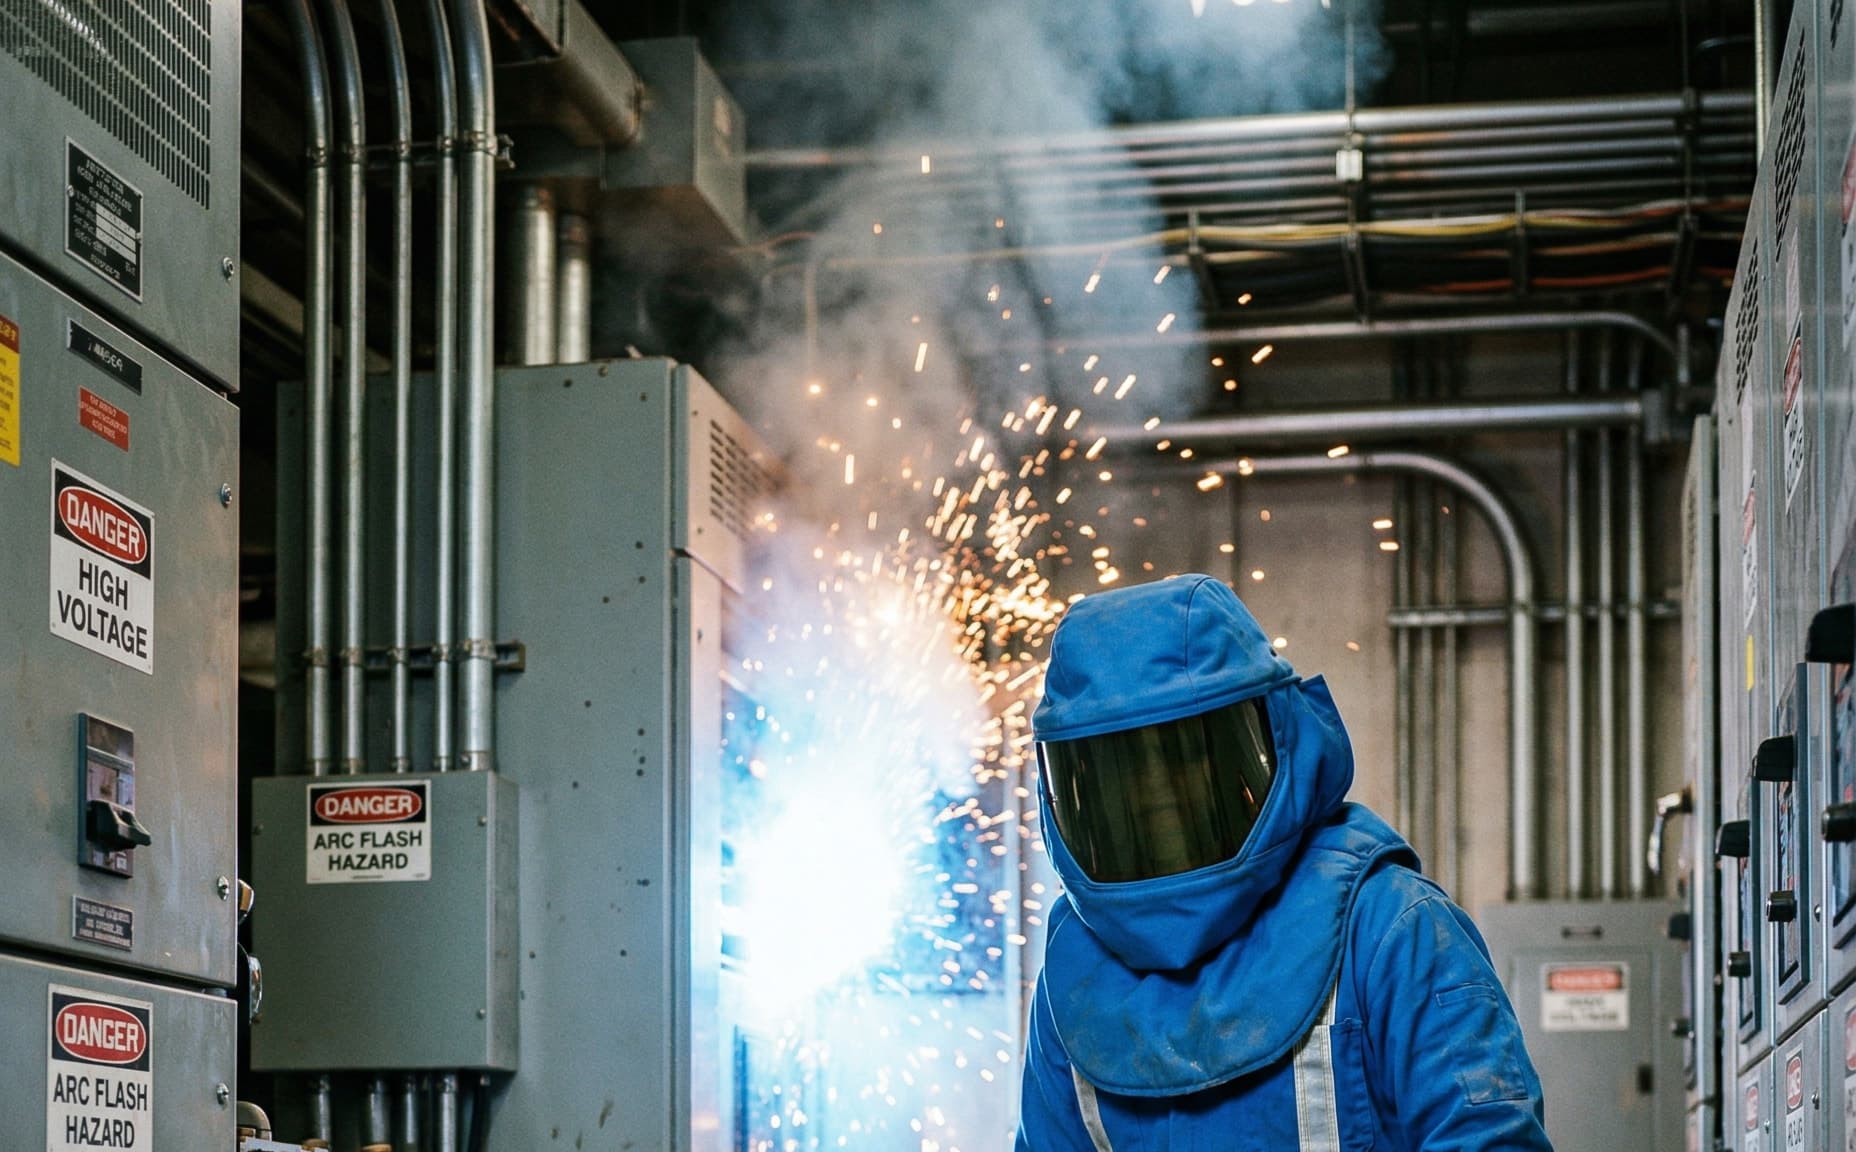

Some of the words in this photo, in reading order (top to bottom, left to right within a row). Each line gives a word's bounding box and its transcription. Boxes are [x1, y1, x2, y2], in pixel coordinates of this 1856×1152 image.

[66, 492, 140, 558] DANGER
[79, 558, 128, 611] HIGH
[57, 590, 148, 659] VOLTAGE
[324, 795, 413, 817] DANGER
[314, 832, 355, 850] ARC
[360, 830, 422, 849] FLASH
[328, 853, 409, 871] HAZARD
[63, 1013, 140, 1053] DANGER
[53, 1072, 90, 1106] ARC
[95, 1077, 148, 1112] FLASH
[65, 1114, 135, 1149] HAZARD
